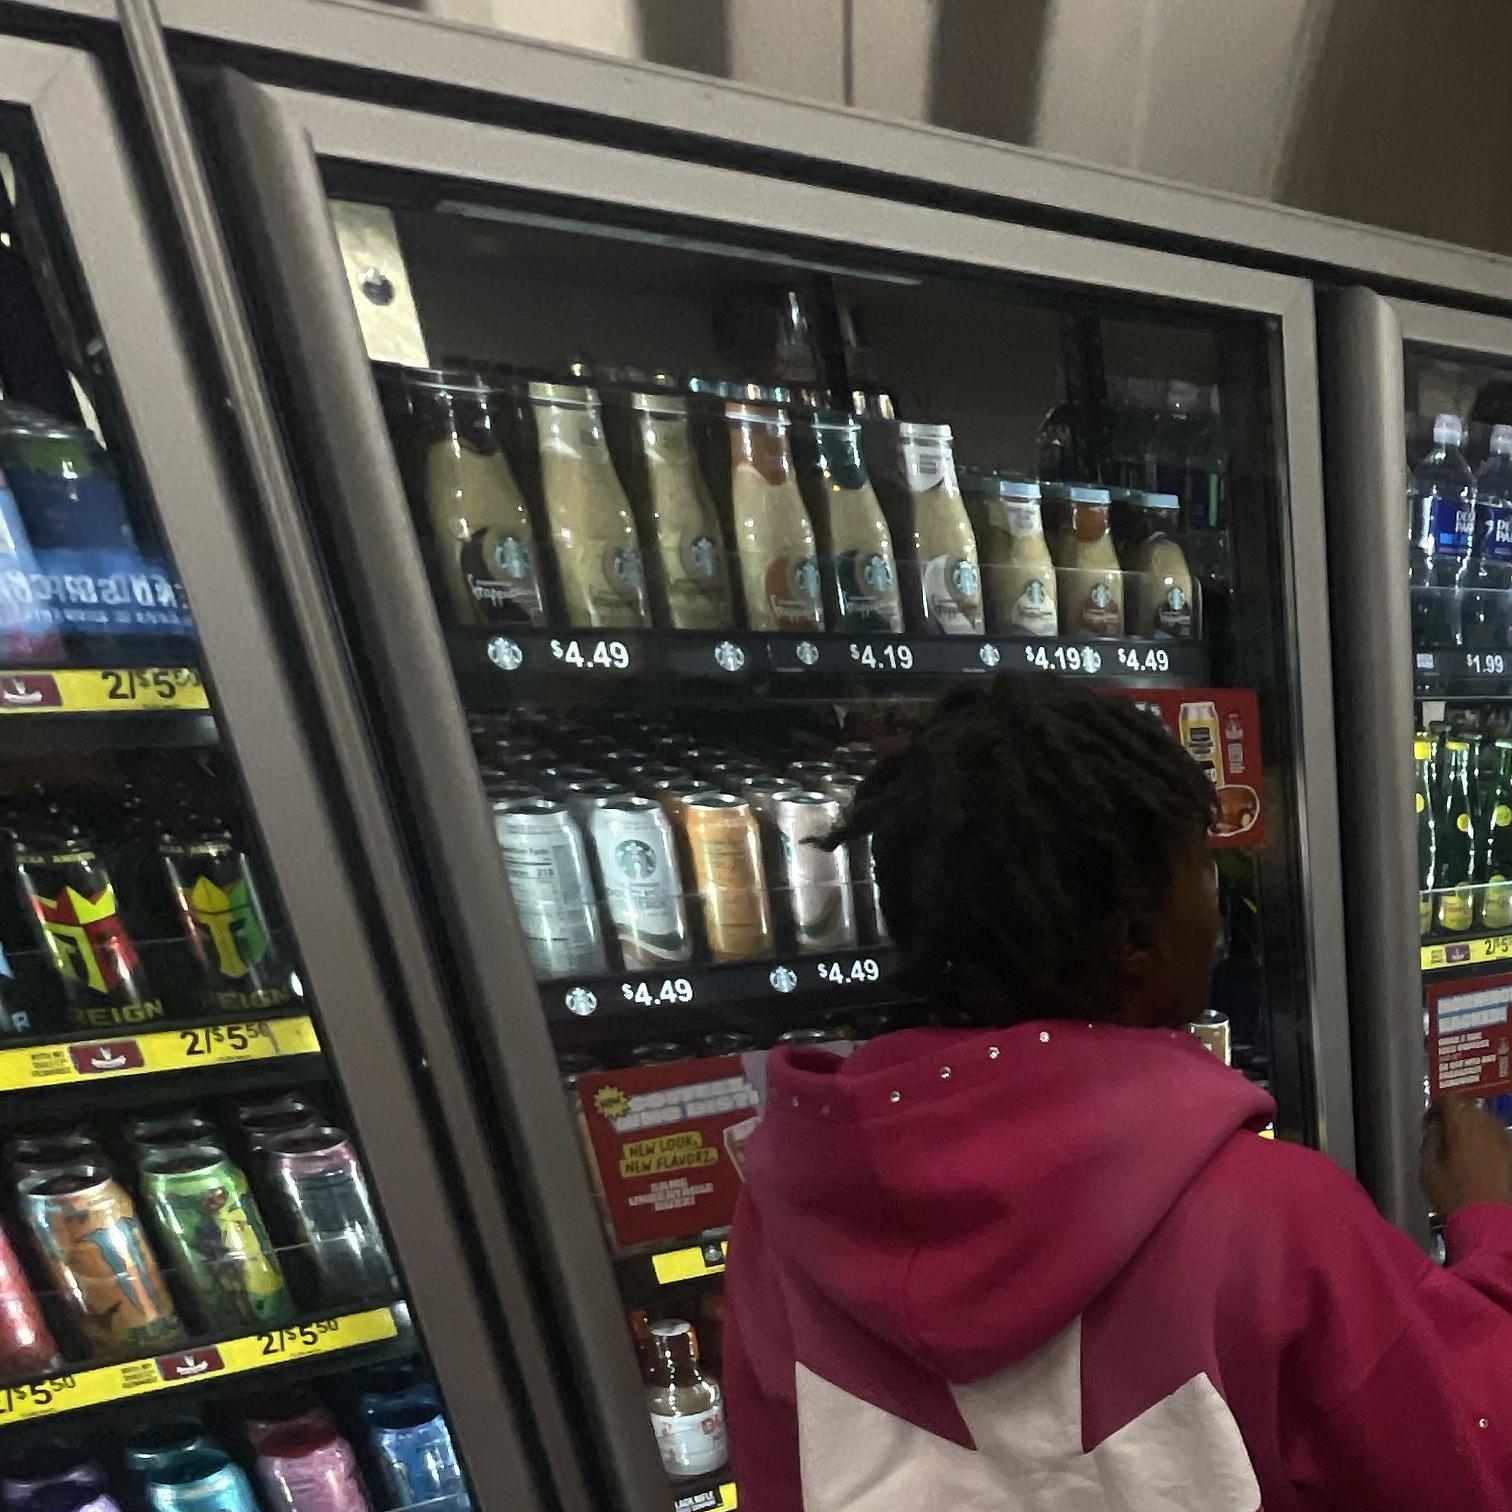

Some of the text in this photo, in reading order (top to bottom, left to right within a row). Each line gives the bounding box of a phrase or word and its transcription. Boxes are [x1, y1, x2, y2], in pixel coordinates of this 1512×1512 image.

[551, 639, 630, 669] $4.49
[850, 643, 913, 670] $4.19
[1025, 646, 1083, 671] $4.19
[1118, 648, 1169, 672] $4.49
[1467, 653, 1504, 674] $1.99
[818, 958, 880, 984] $4.49
[621, 978, 694, 1007] $4.49
[630, 1143, 656, 1158] NEW
[625, 1159, 652, 1174] NEW
